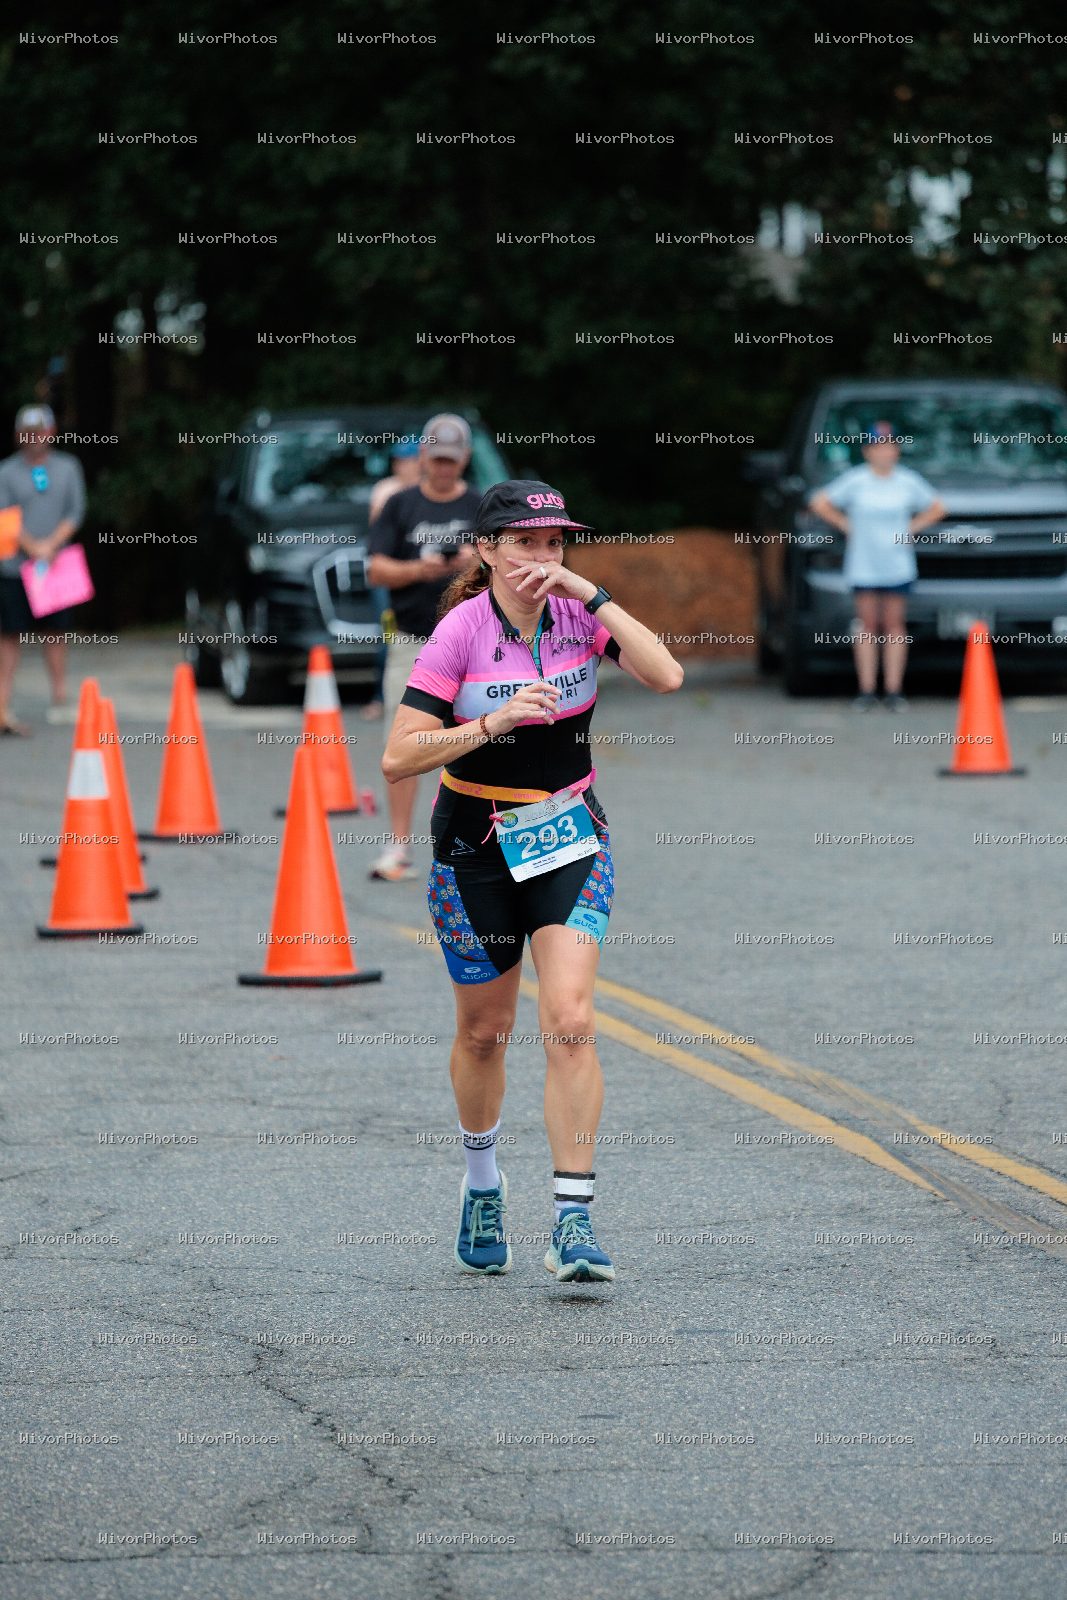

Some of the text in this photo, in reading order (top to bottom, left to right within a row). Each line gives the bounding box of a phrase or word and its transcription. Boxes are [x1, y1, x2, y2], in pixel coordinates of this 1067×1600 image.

[527, 492, 565, 509] guts
[486, 667, 587, 699] GREVILLE
[518, 815, 578, 860] 293
